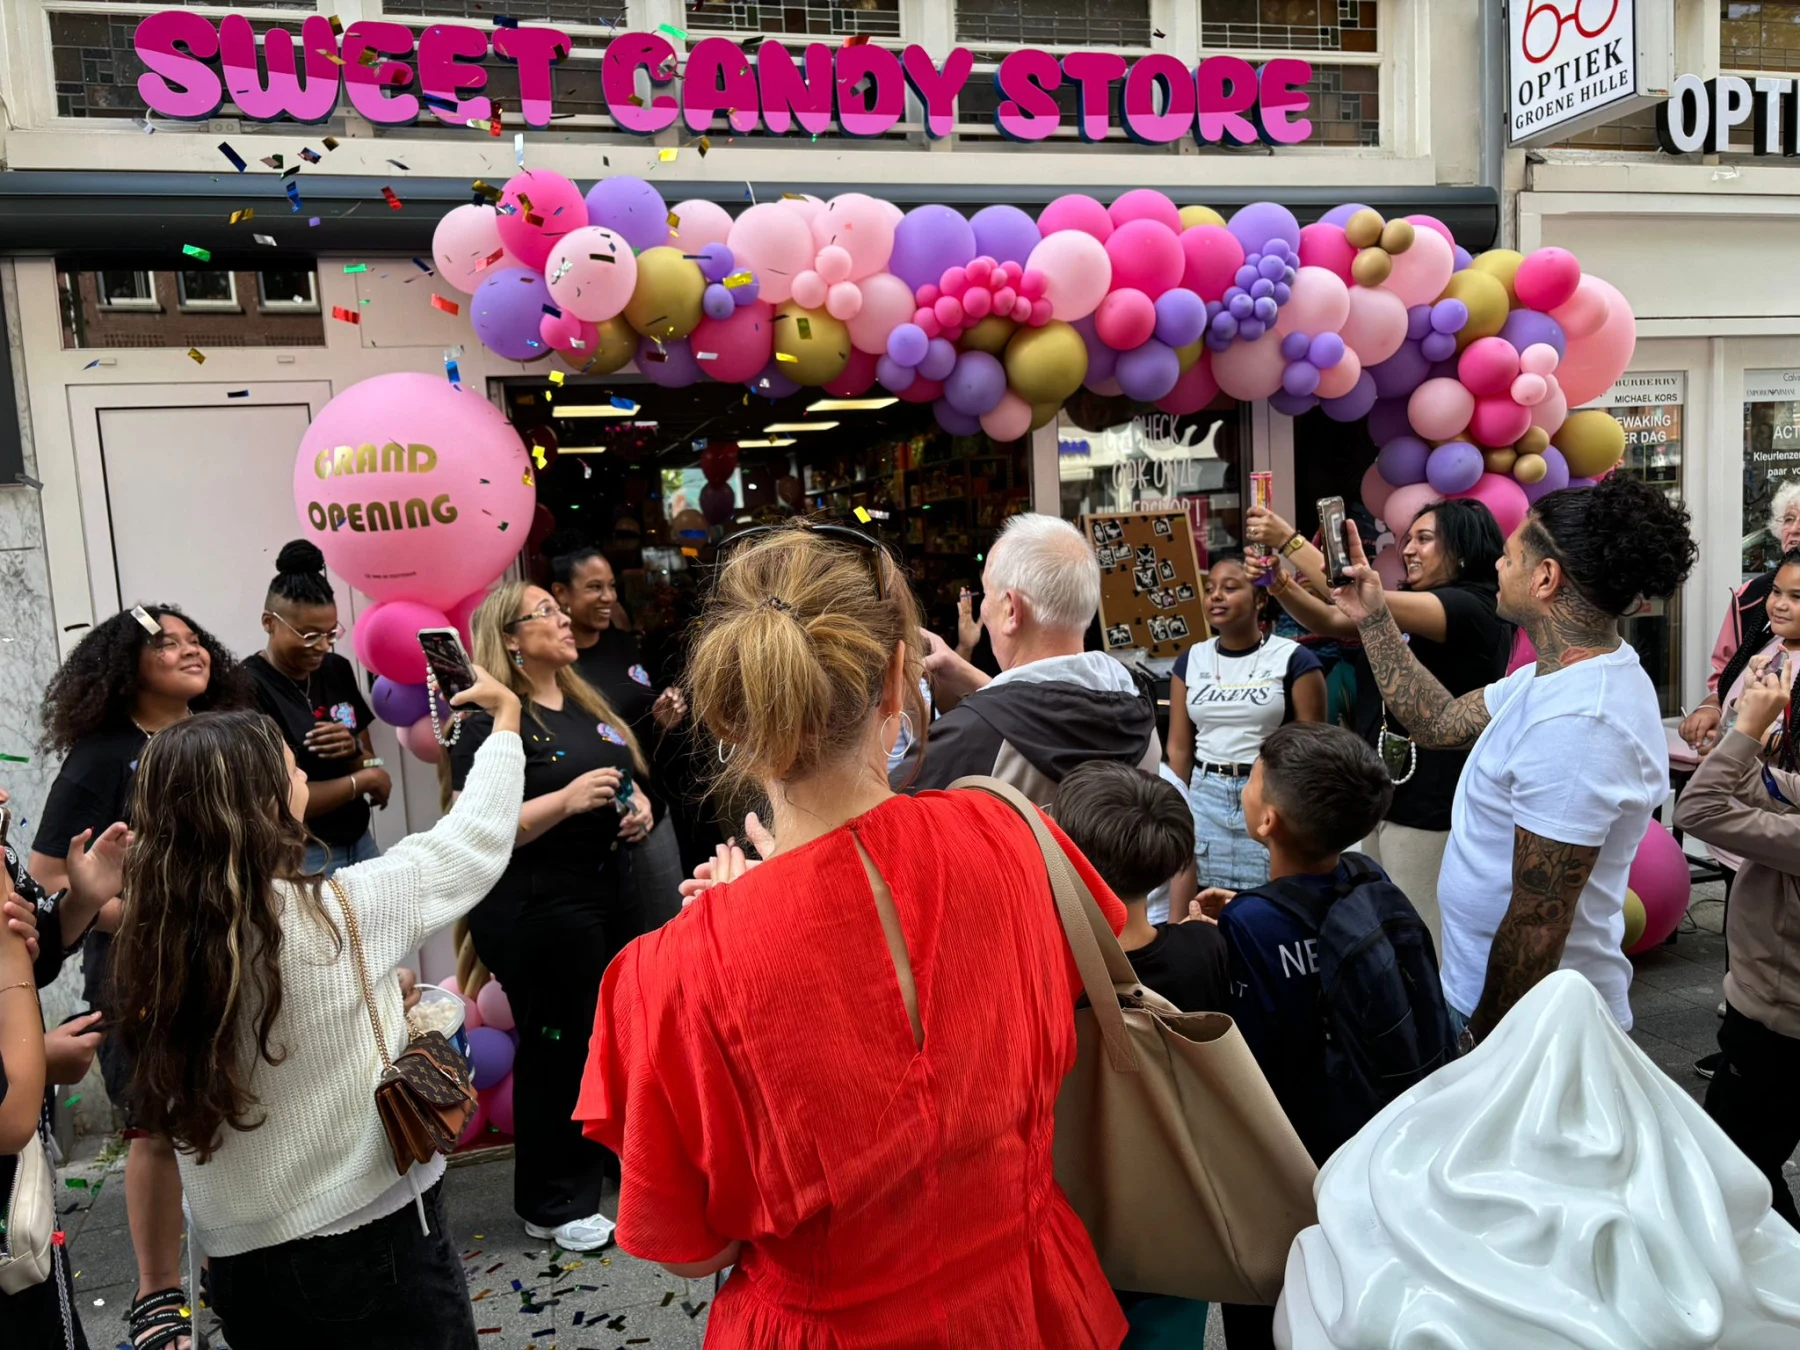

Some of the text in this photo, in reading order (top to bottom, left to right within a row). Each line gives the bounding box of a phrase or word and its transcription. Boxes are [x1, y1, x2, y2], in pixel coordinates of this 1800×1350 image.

[134, 10, 1313, 144] SWEET CANDY STORE
[1518, 37, 1623, 106] OPTIEK
[1515, 69, 1628, 129] GROENE HILLE
[1666, 73, 1800, 154] OPT
[1614, 393, 1678, 403] MICHAEL KORS
[1615, 377, 1678, 387] BURBERRY
[1131, 414, 1180, 446] CHECK
[1640, 430, 1667, 444] DAG
[314, 443, 438, 479] GRAND
[1112, 456, 1195, 489] OOK ONZE
[1767, 467, 1788, 479] paar
[307, 493, 458, 532] OPENING
